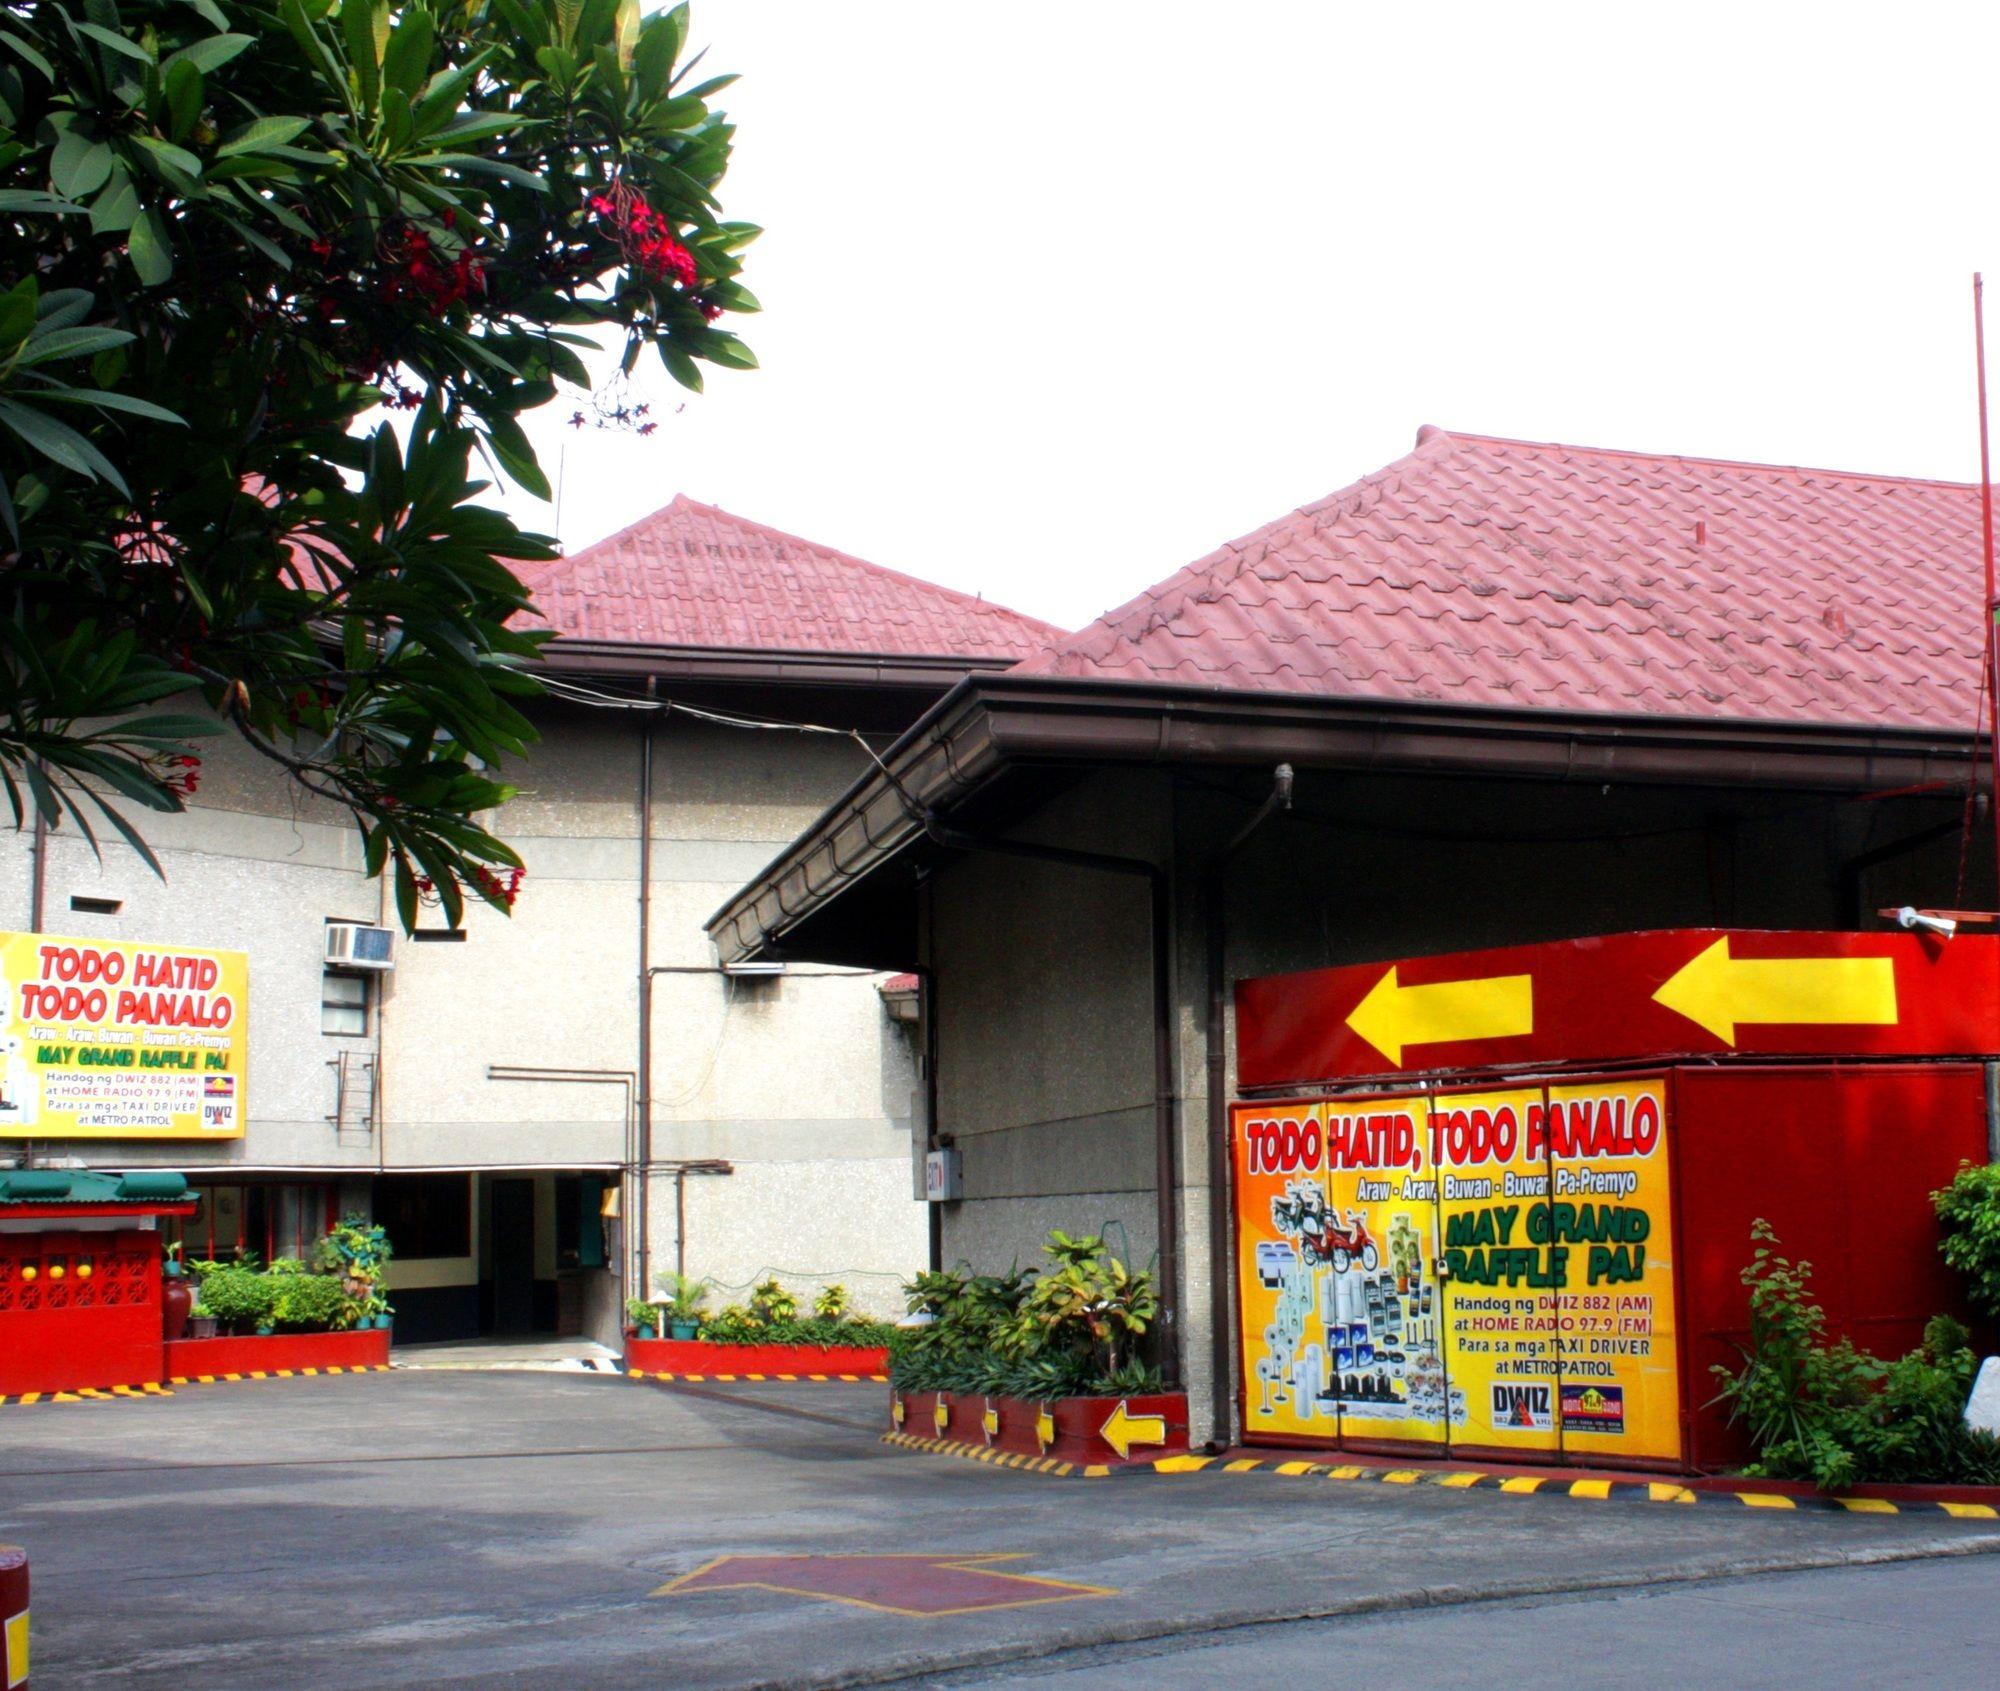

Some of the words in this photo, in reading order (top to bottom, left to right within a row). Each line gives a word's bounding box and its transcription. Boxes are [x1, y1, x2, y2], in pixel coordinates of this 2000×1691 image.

[40, 946, 124, 985] TODO
[133, 953, 218, 990] HATID
[21, 984, 107, 1022] TODO
[115, 991, 232, 1029] PANALO
[37, 1045, 73, 1064] MAY
[78, 1047, 135, 1067] GRAND
[139, 1050, 197, 1069] RAFFLE
[46, 1073, 93, 1085] Handog
[97, 1076, 112, 1086] ng
[115, 1074, 147, 1083] DWIZ
[150, 1076, 171, 1084] 882
[46, 1087, 57, 1095] at
[61, 1086, 99, 1096] HOME
[104, 1087, 143, 1097] RADIO
[147, 1088, 171, 1097] 979
[48, 1100, 74, 1109] Para
[79, 1102, 90, 1110] sa
[94, 1103, 118, 1113] mga
[122, 1102, 149, 1111] TAXI
[153, 1102, 196, 1112] DRIVER
[78, 1116, 88, 1124] at
[92, 1115, 129, 1125] METRO
[131, 1115, 171, 1125] PATROL
[1247, 1119, 1322, 1173] TODO
[1328, 1113, 1422, 1173] HATID,
[1427, 1106, 1517, 1166] TODO
[1526, 1096, 1659, 1161] PANALO
[1356, 1178, 1391, 1203] Araw
[1444, 1174, 1491, 1200] Buwan
[1555, 1168, 1637, 1199] Pa-Premyo
[1445, 1205, 1519, 1247] MAY
[1526, 1202, 1650, 1245] GRAND
[1444, 1246, 1569, 1288] RAFFLE
[1586, 1244, 1645, 1286] PA!
[1454, 1297, 1511, 1314] Handog
[1515, 1299, 1534, 1314] ng
[1539, 1296, 1578, 1310] DWIZ
[1583, 1296, 1610, 1310] 882
[1616, 1296, 1653, 1314] (AM)
[1454, 1318, 1469, 1331] at
[1473, 1317, 1519, 1331] HOME
[1524, 1317, 1574, 1331] RADO
[1579, 1318, 1613, 1331] 97.9
[1618, 1318, 1653, 1337] (FM)
[1459, 1338, 1489, 1352] Para
[1495, 1341, 1509, 1352] sa
[1515, 1341, 1545, 1356] mga
[1550, 1339, 1584, 1353] TAXI
[1590, 1340, 1650, 1355] DRIVER
[1496, 1361, 1509, 1373] at
[1513, 1360, 1557, 1375] METRO
[1559, 1360, 1615, 1377] PATROL
[1493, 1386, 1550, 1413] DWIZ
